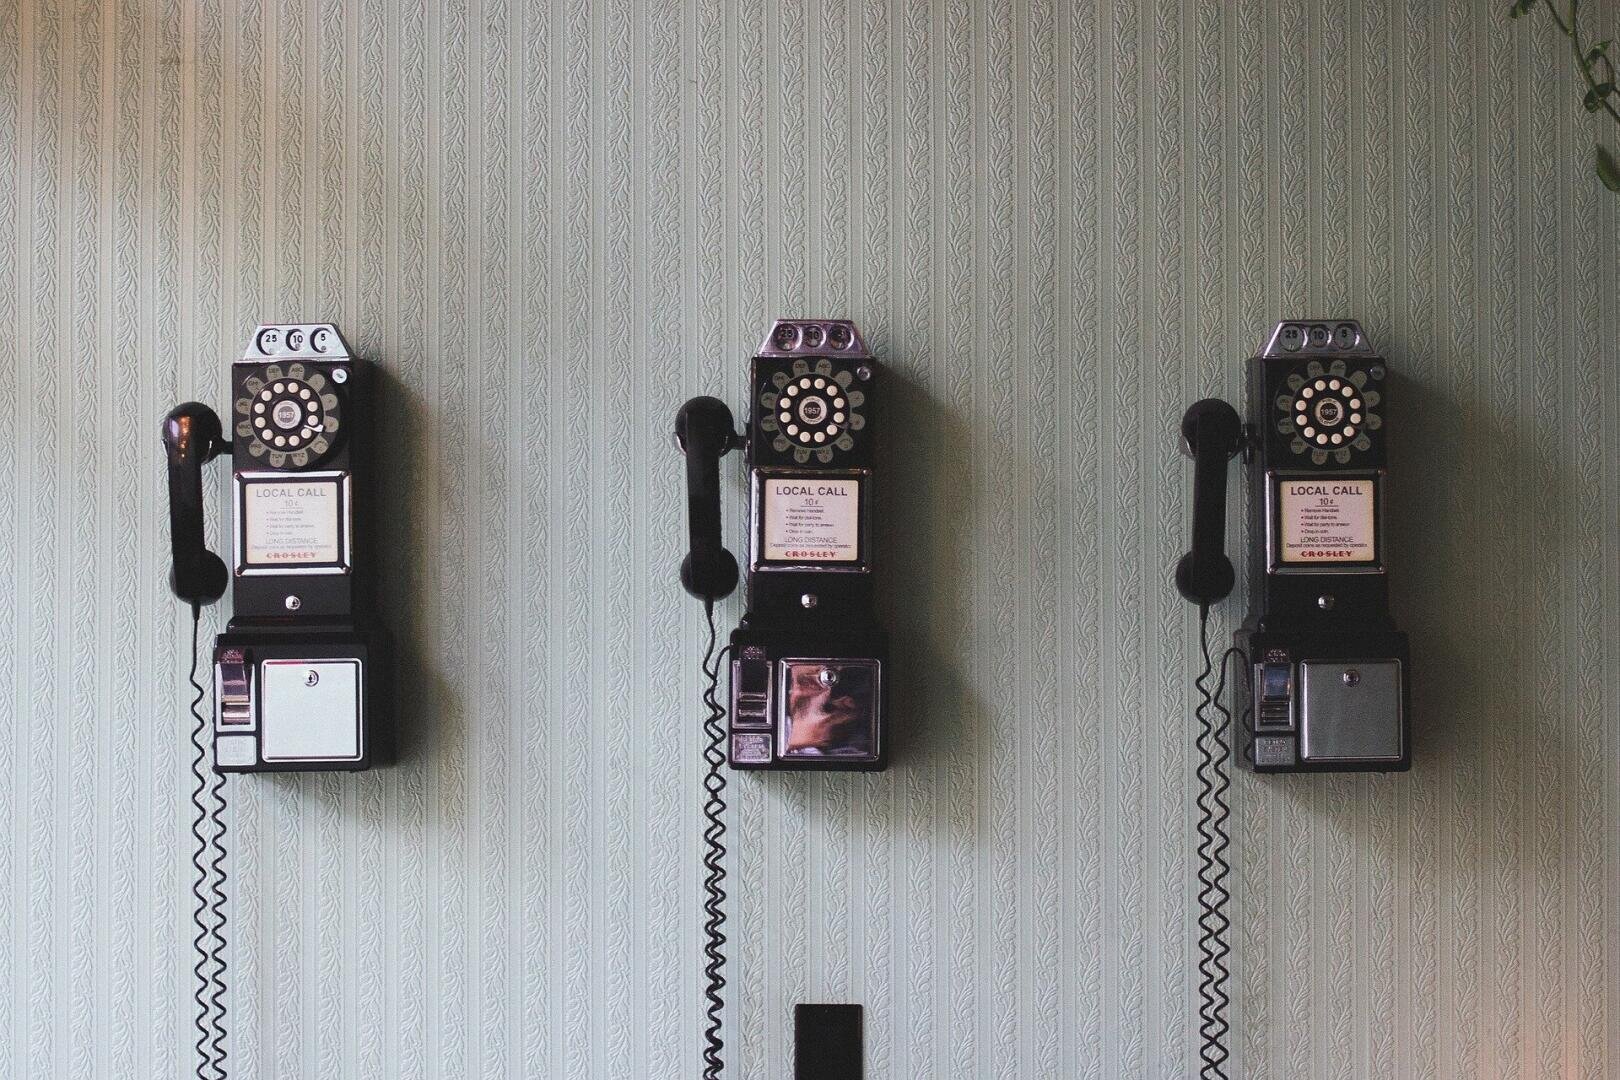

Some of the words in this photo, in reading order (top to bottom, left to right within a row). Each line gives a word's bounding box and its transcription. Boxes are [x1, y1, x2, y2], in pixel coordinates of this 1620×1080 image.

[265, 334, 277, 343] 25
[293, 335, 303, 344] 10
[320, 333, 326, 341] 5
[1285, 330, 1298, 339] 25
[1314, 330, 1324, 340] 10
[804, 406, 821, 414] 1957
[256, 488, 294, 498] LOCAL
[297, 488, 327, 497] CALL
[776, 486, 814, 496] LOCAL
[817, 487, 848, 497] CALL
[1290, 486, 1329, 496] LOCAL
[1333, 486, 1363, 495] CALL
[804, 536, 838, 544] DISTANCE
[784, 550, 836, 558] CROSLEY
[1301, 550, 1352, 558] CROSLEY
